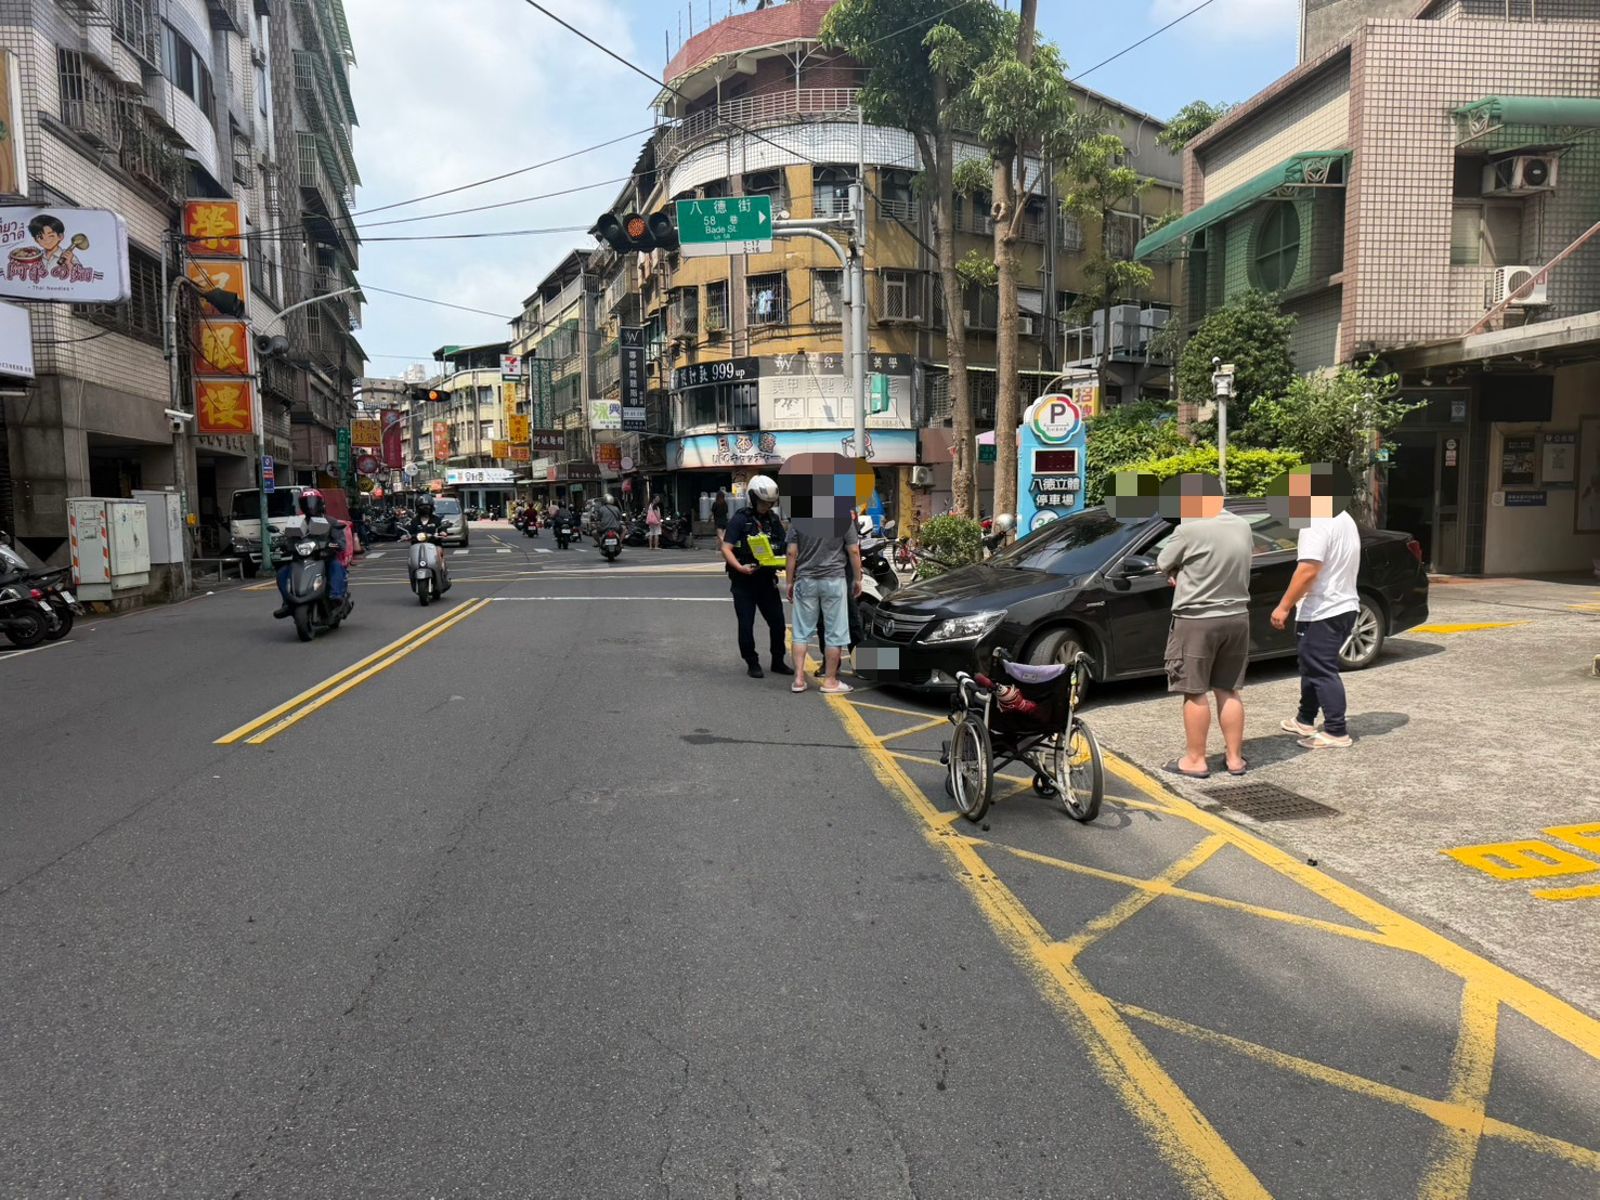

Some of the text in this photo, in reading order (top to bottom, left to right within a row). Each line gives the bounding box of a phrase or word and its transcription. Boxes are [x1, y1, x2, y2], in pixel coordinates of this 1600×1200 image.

[690, 199, 752, 215] 八德街
[703, 216, 717, 226] 58
[705, 225, 725, 234] Bade
[1050, 403, 1067, 424] P
[1036, 494, 1074, 506] 停車場
